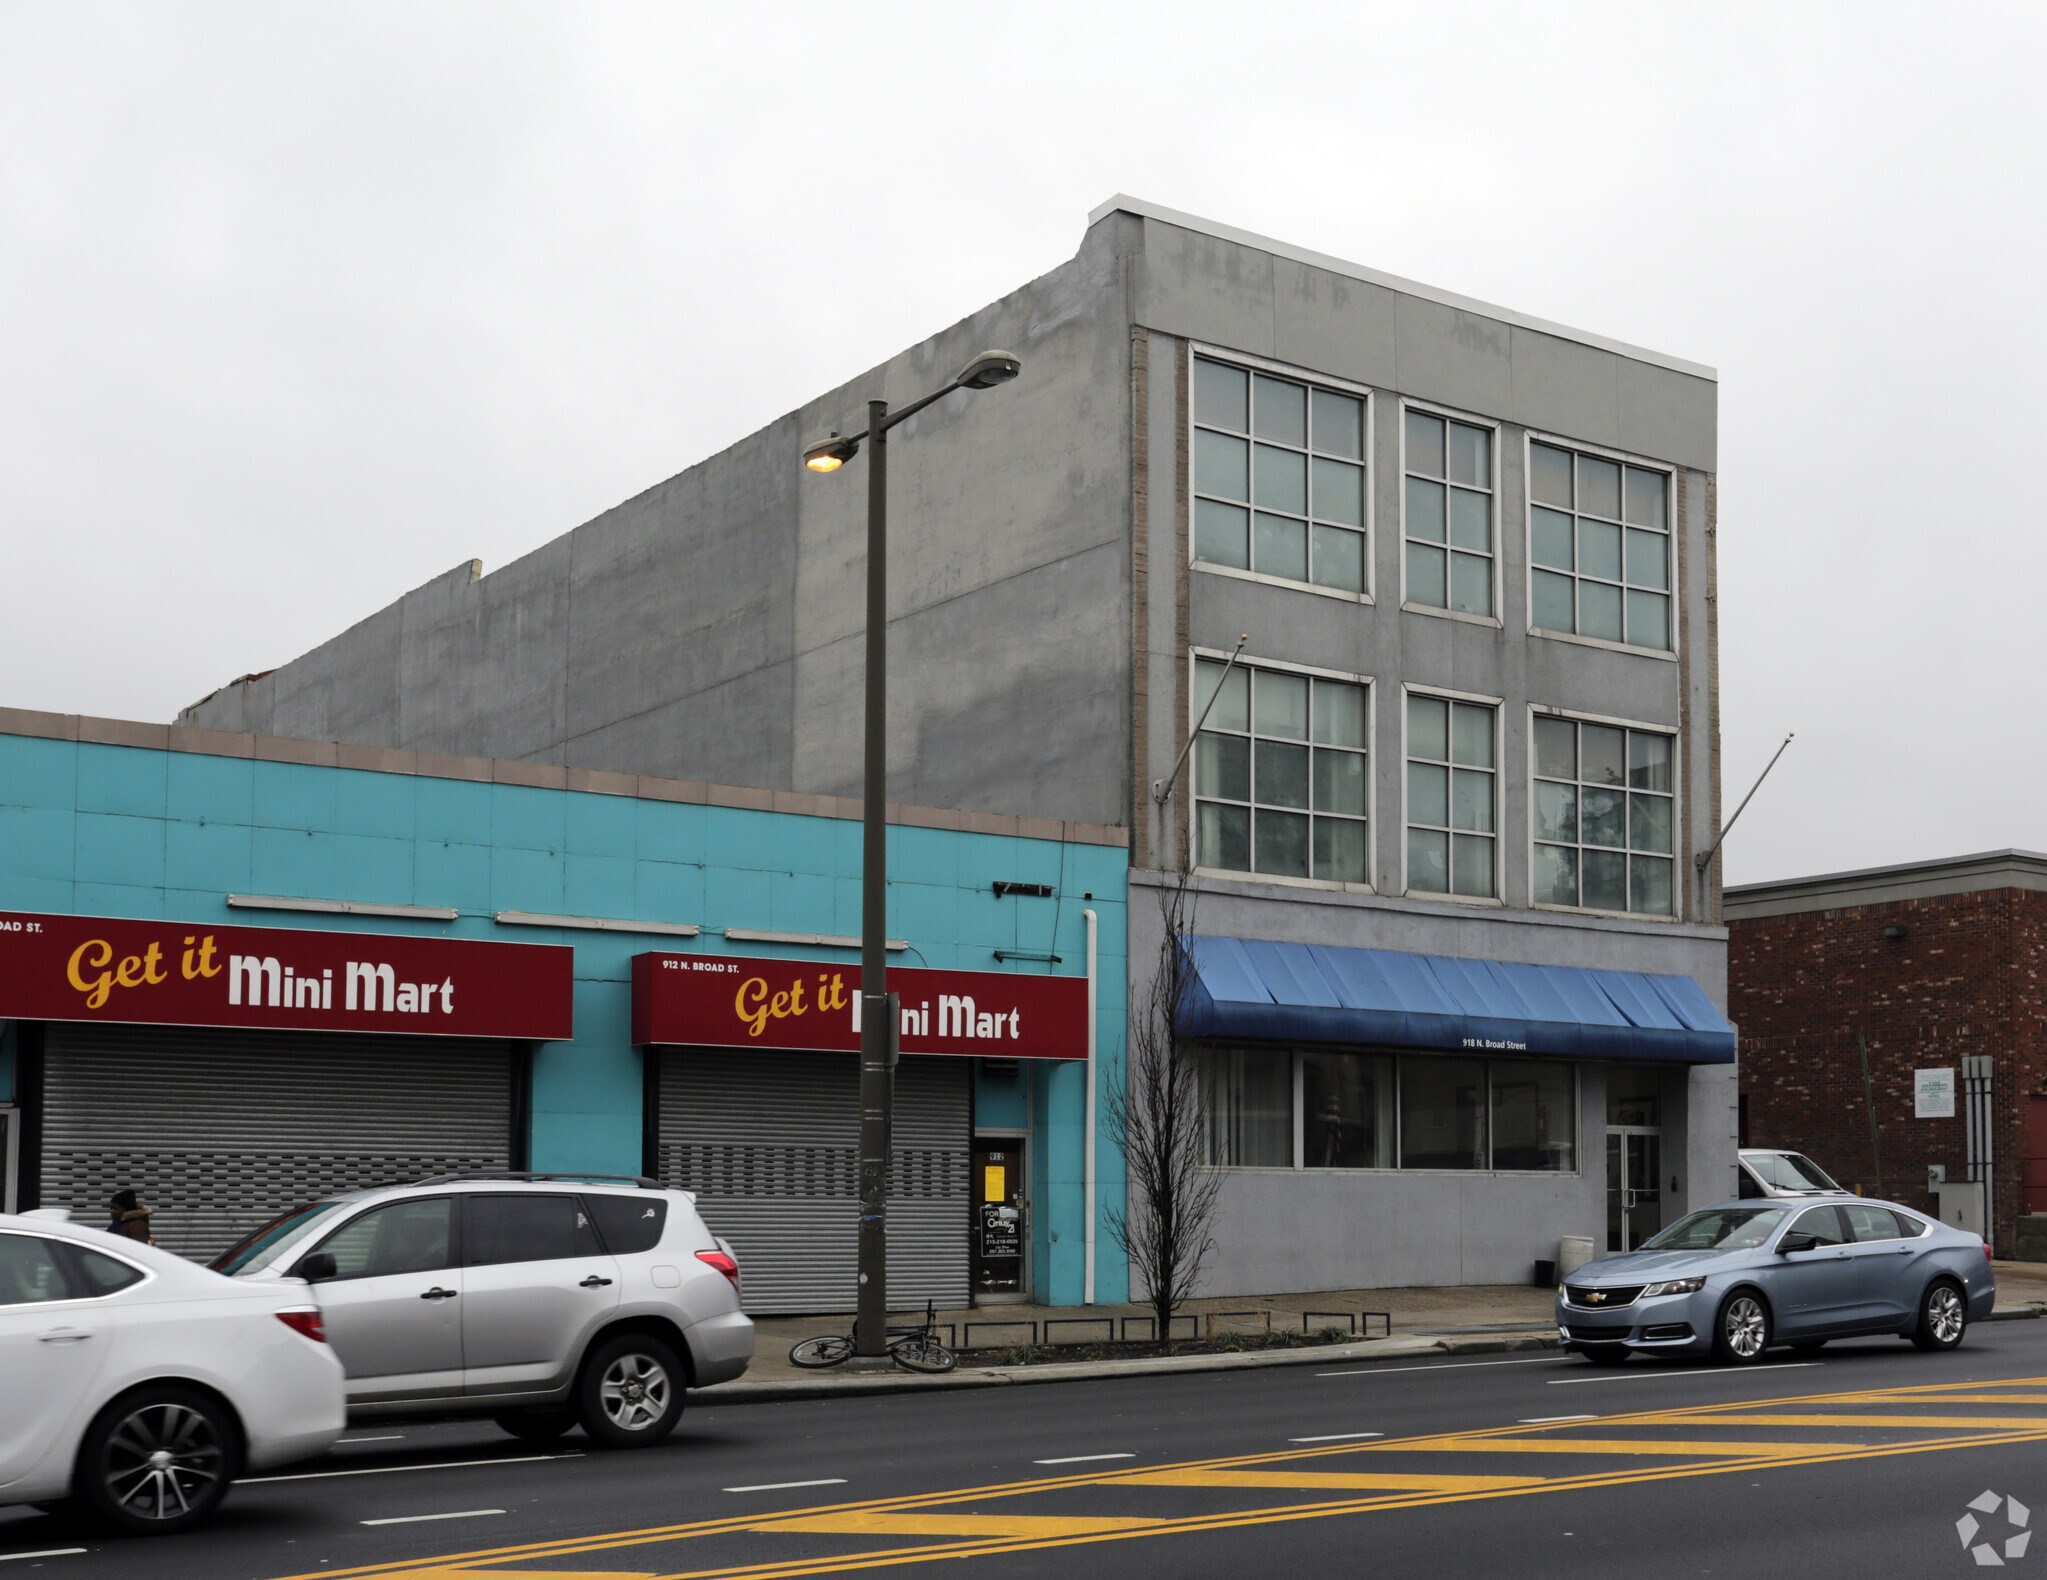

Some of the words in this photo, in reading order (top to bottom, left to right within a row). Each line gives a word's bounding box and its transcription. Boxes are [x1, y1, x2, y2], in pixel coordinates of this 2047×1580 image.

[26, 922, 43, 933] ST.
[662, 960, 678, 969] 912
[681, 961, 690, 970] N.
[693, 962, 725, 972] BROAD
[727, 964, 740, 974] ST.
[67, 939, 168, 1009] Get
[182, 935, 222, 980] it
[229, 955, 332, 1010] Mini
[345, 961, 454, 1014] Mart
[735, 977, 808, 1037] Get
[817, 973, 848, 1012] it
[852, 989, 929, 1036] ni
[938, 994, 1020, 1040] Mart
[1463, 1039, 1475, 1047] 918
[1476, 1039, 1484, 1047] N.
[1486, 1040, 1505, 1049] Broad
[1507, 1041, 1526, 1050] Street
[991, 1152, 1004, 1160] 912
